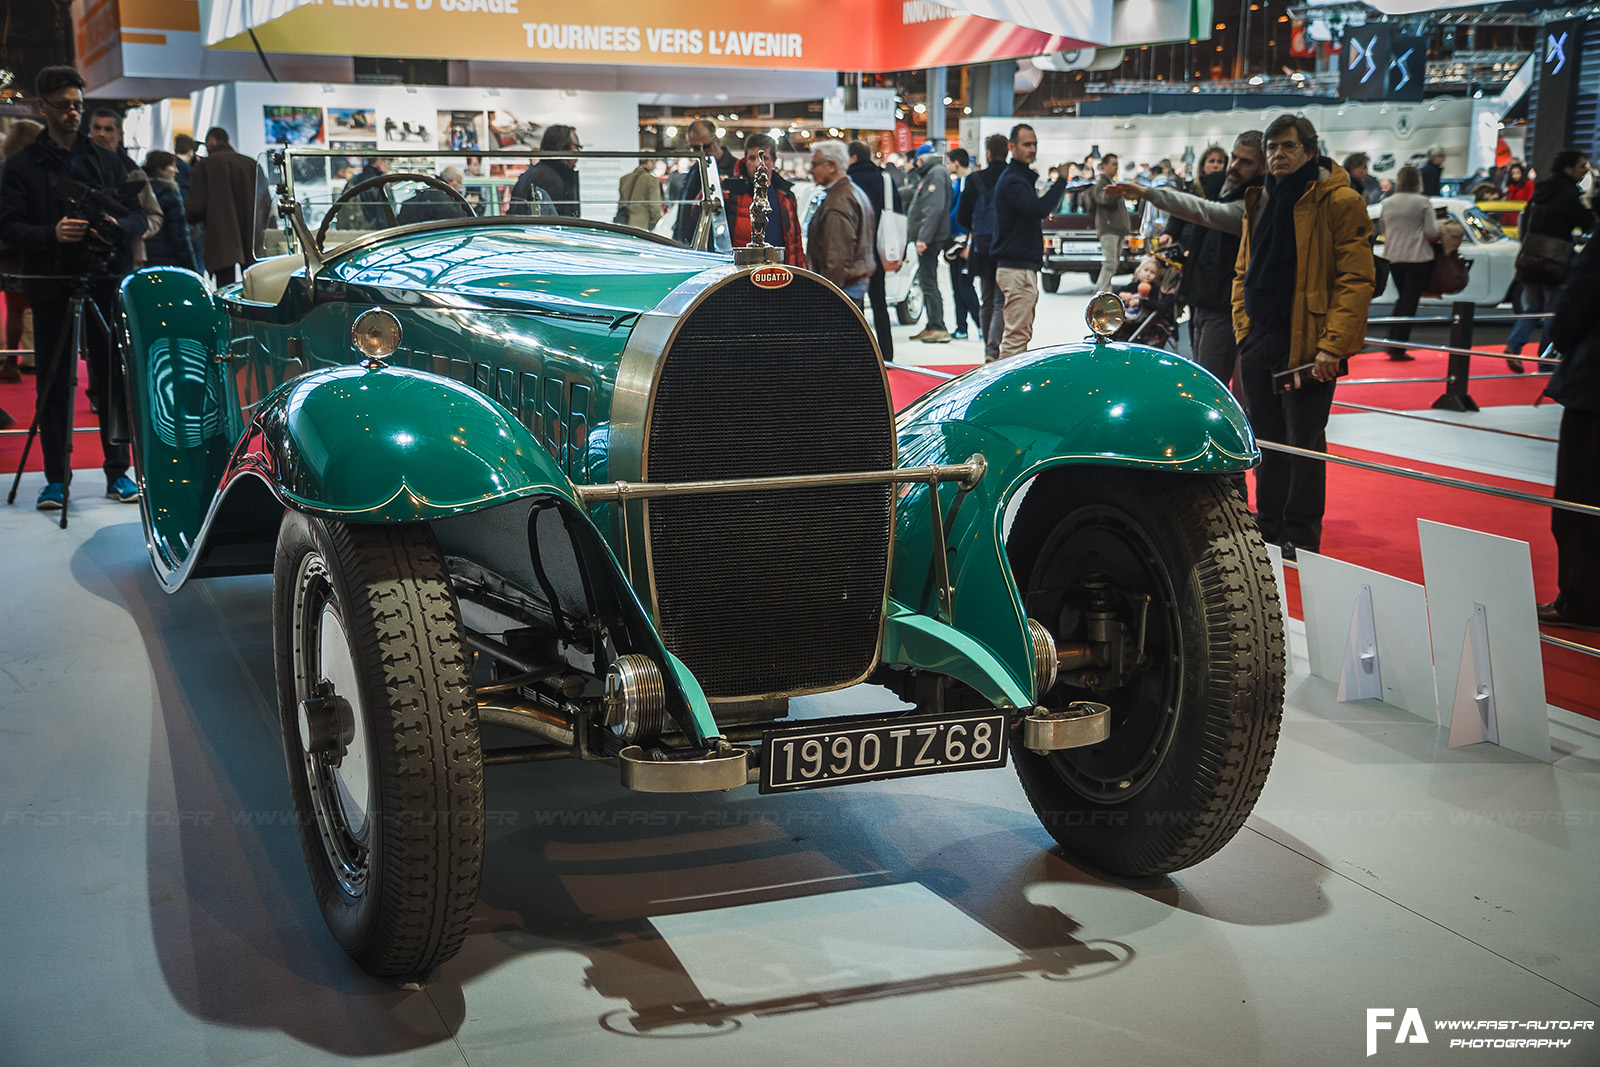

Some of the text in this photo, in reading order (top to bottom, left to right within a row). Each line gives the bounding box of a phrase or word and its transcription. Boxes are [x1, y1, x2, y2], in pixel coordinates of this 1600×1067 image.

[522, 22, 803, 58] TOURNEES VERS L'AVENIR
[755, 273, 790, 282] BUGATTI
